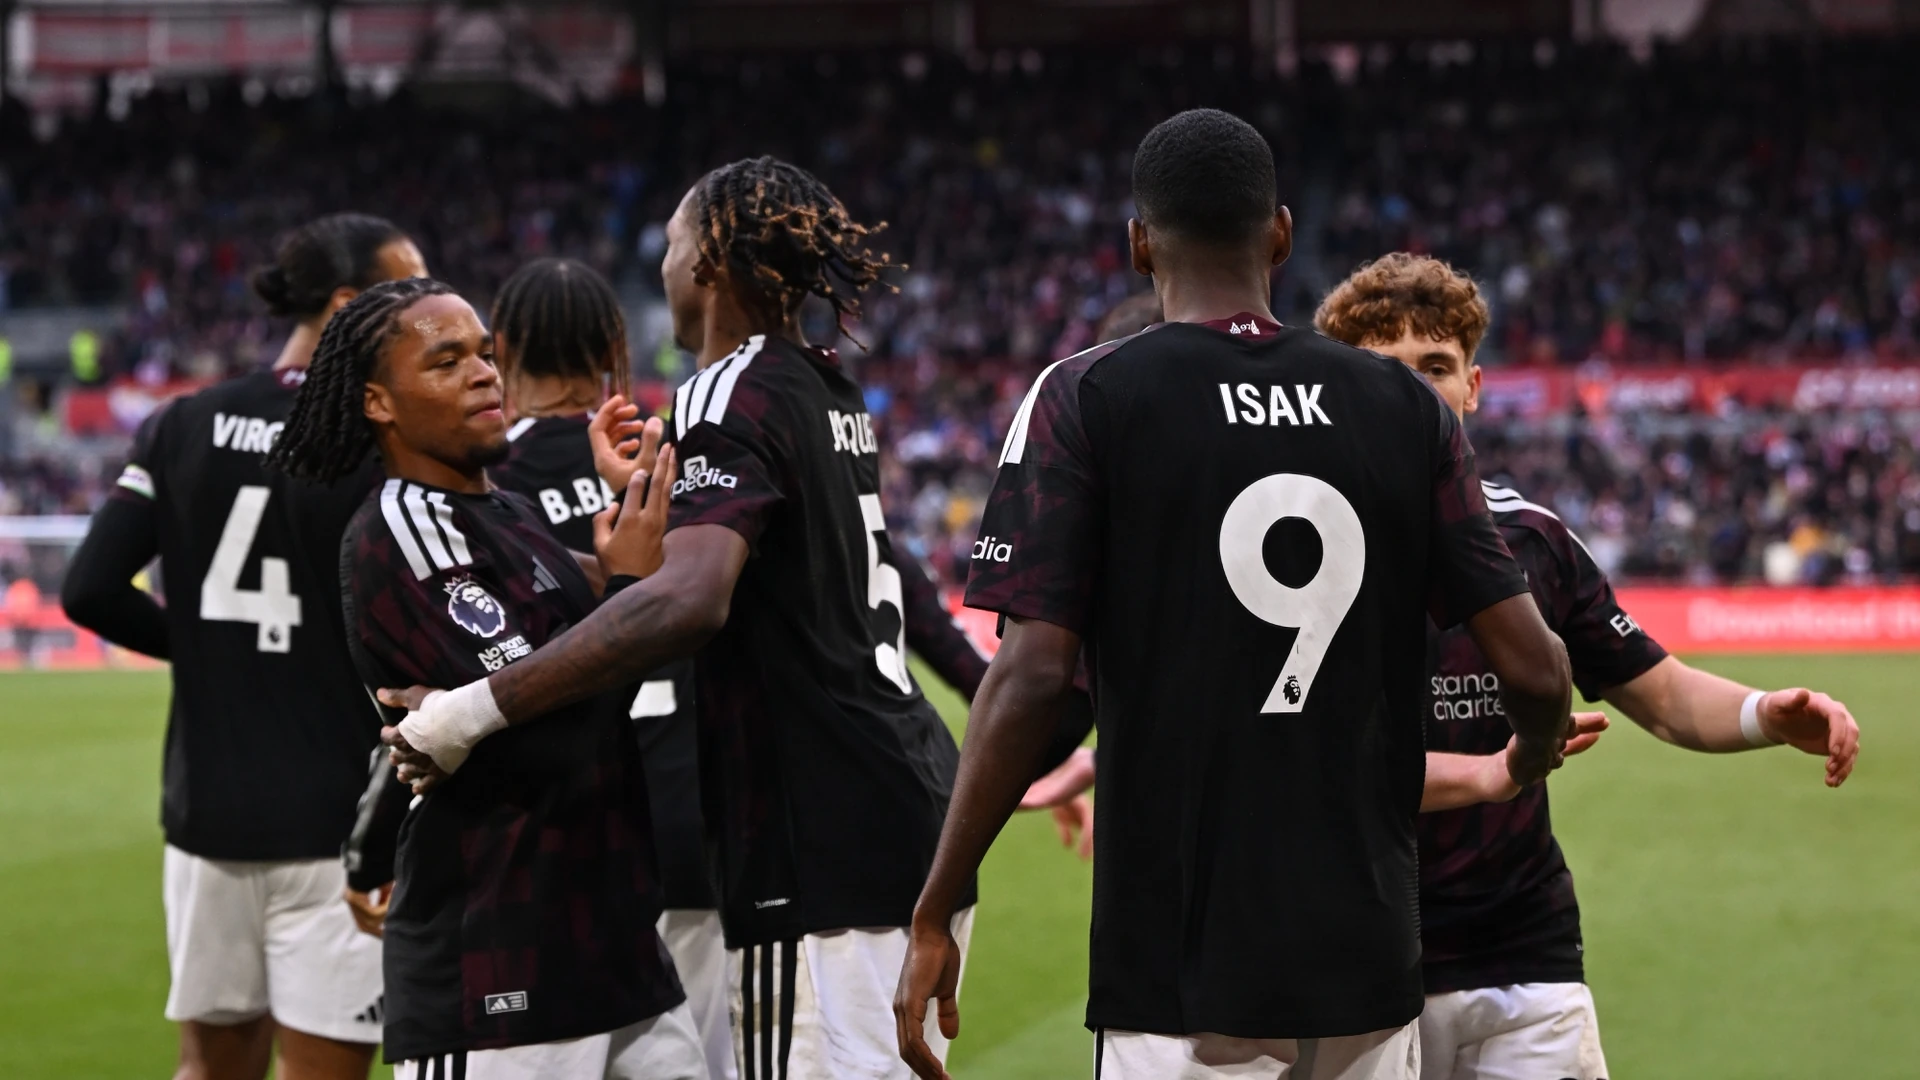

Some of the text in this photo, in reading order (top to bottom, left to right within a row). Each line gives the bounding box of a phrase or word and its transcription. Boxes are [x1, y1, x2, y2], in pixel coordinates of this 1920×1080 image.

[1218, 382, 1333, 426] ISAK
[670, 467, 738, 501] pedia
[200, 485, 302, 653] 4
[971, 536, 1012, 562] dia
[857, 494, 912, 695] 5
[1219, 472, 1366, 714] 9
[478, 646, 501, 664] No
